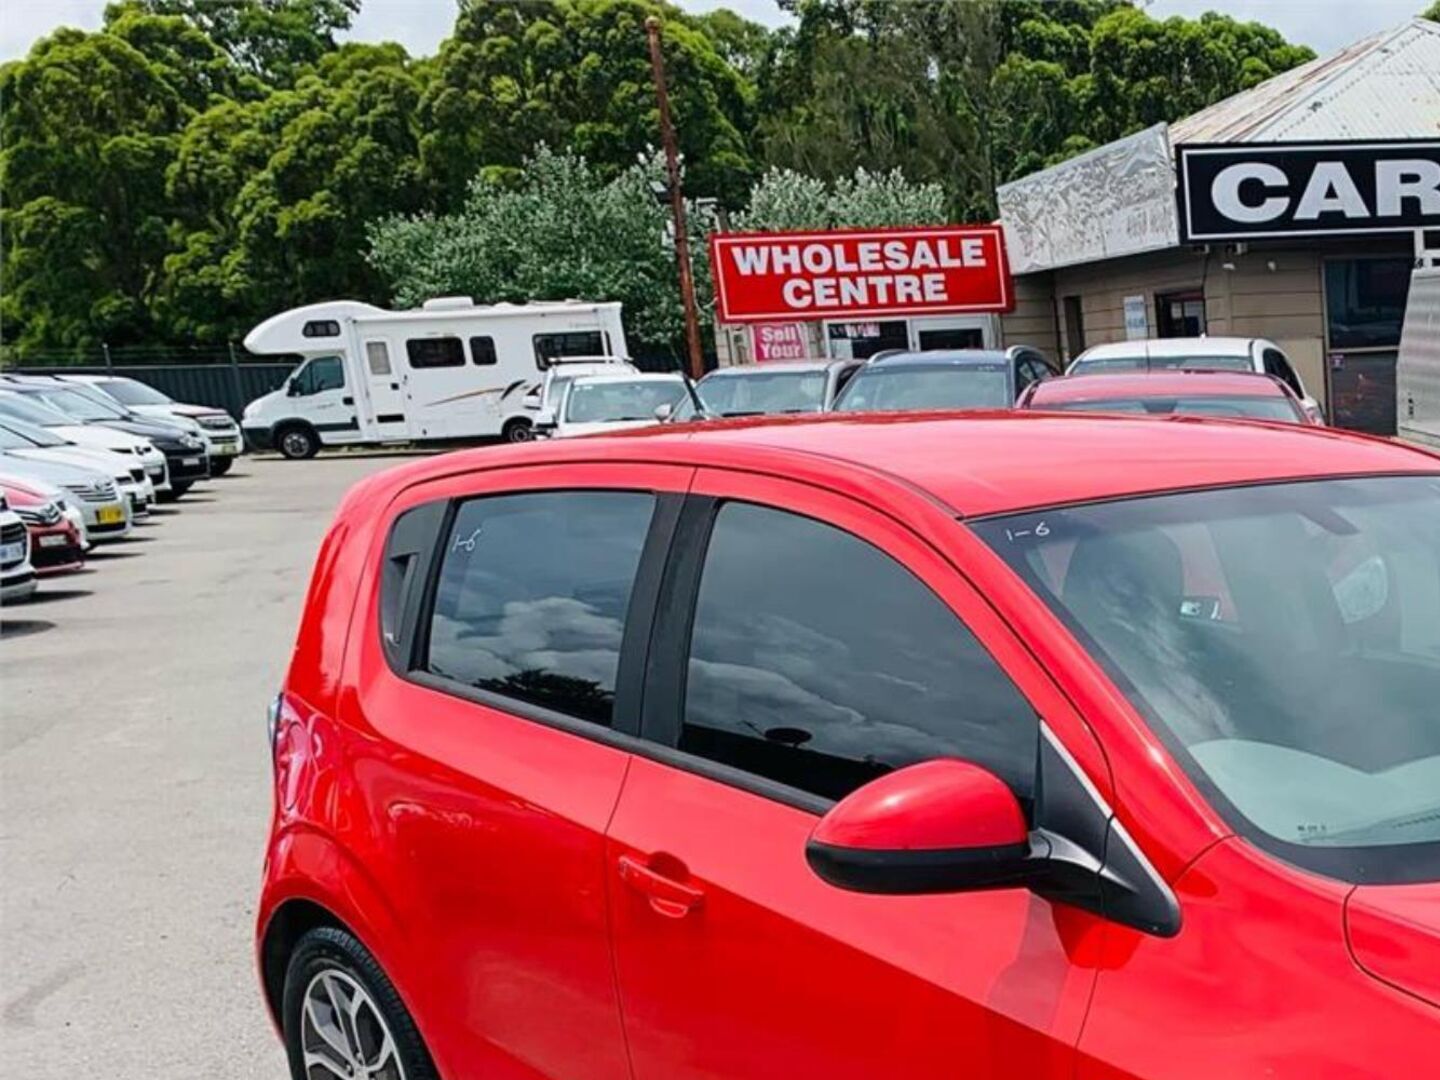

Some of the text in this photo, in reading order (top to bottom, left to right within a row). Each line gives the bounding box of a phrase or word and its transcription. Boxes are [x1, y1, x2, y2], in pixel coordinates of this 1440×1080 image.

[731, 238, 987, 276] WHOLESALE
[782, 273, 948, 308] CENTRE
[761, 325, 798, 343] Sell
[760, 341, 801, 359] Your
